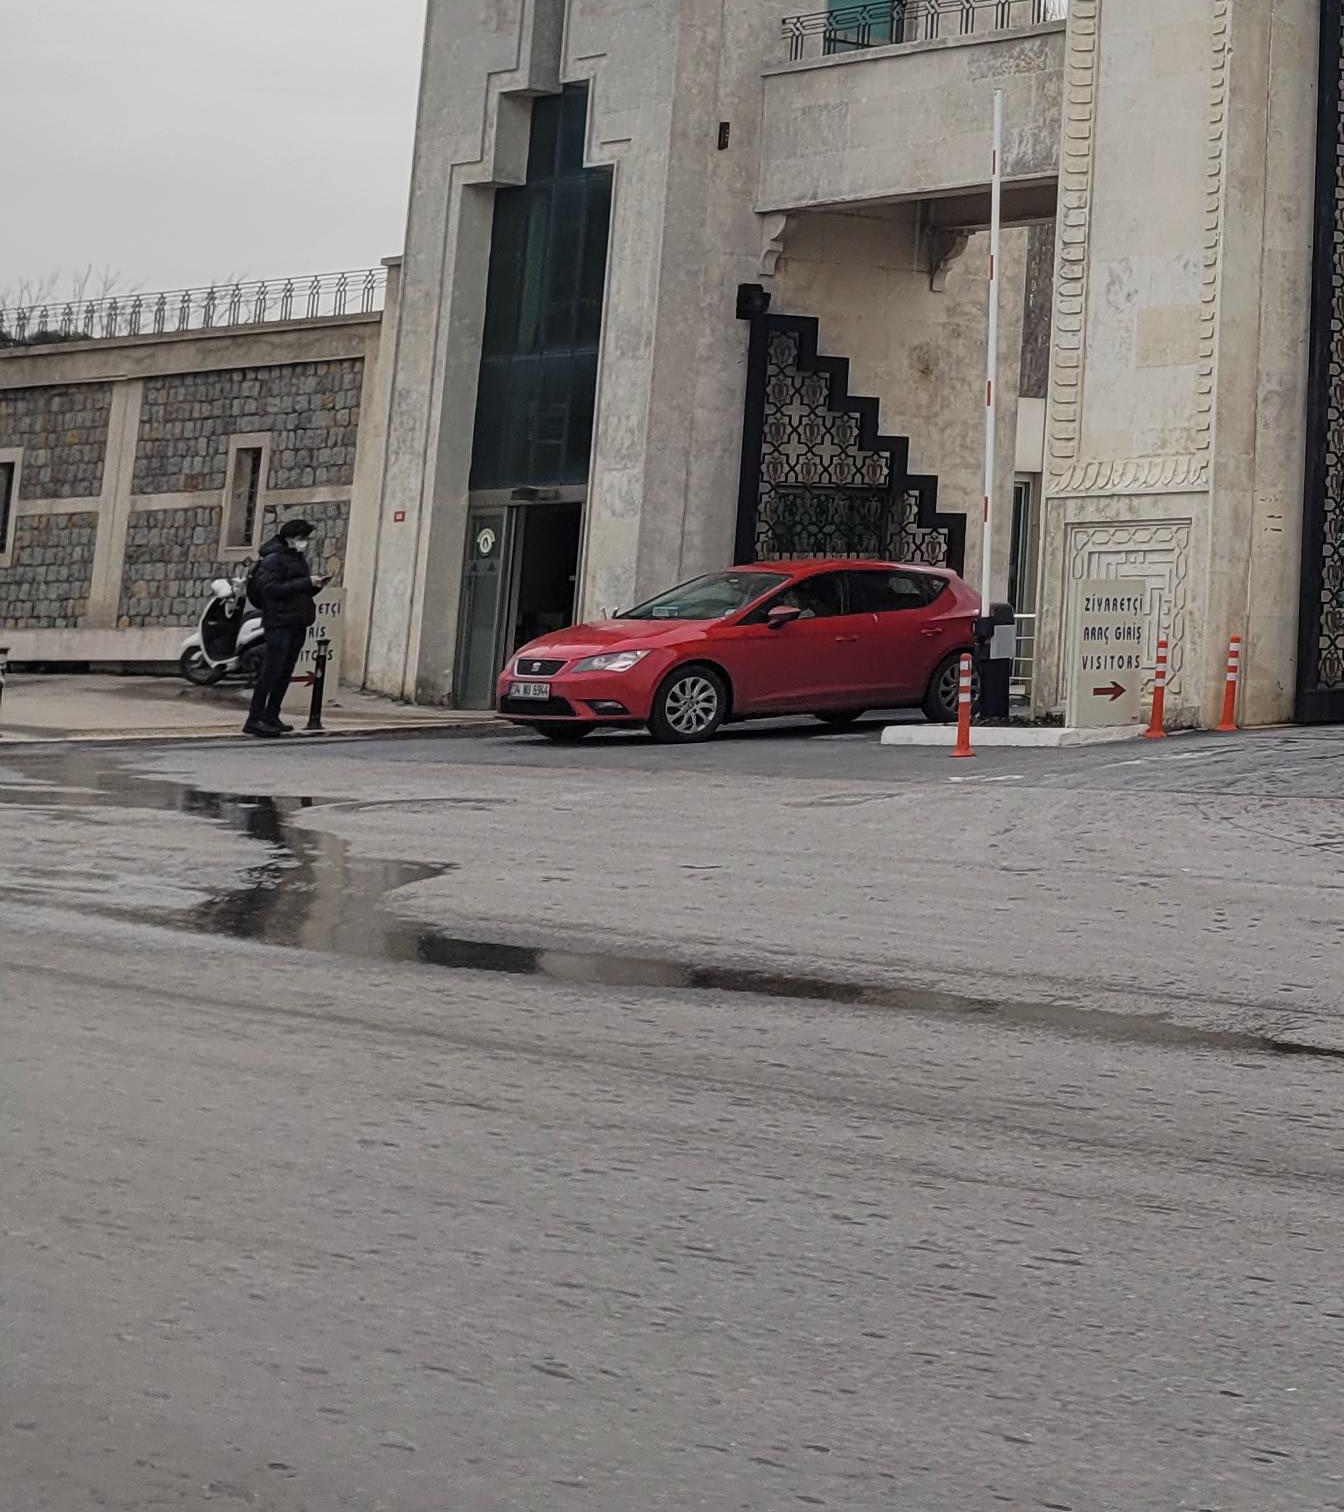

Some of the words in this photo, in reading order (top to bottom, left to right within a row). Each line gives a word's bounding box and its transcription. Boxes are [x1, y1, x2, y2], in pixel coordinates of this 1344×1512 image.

[1084, 593, 1143, 616] ZİYARETÇİ
[1083, 626, 1109, 646] ARAÇ
[1114, 622, 1142, 645] GİRİŞ
[1081, 654, 1140, 671] VISITORS
